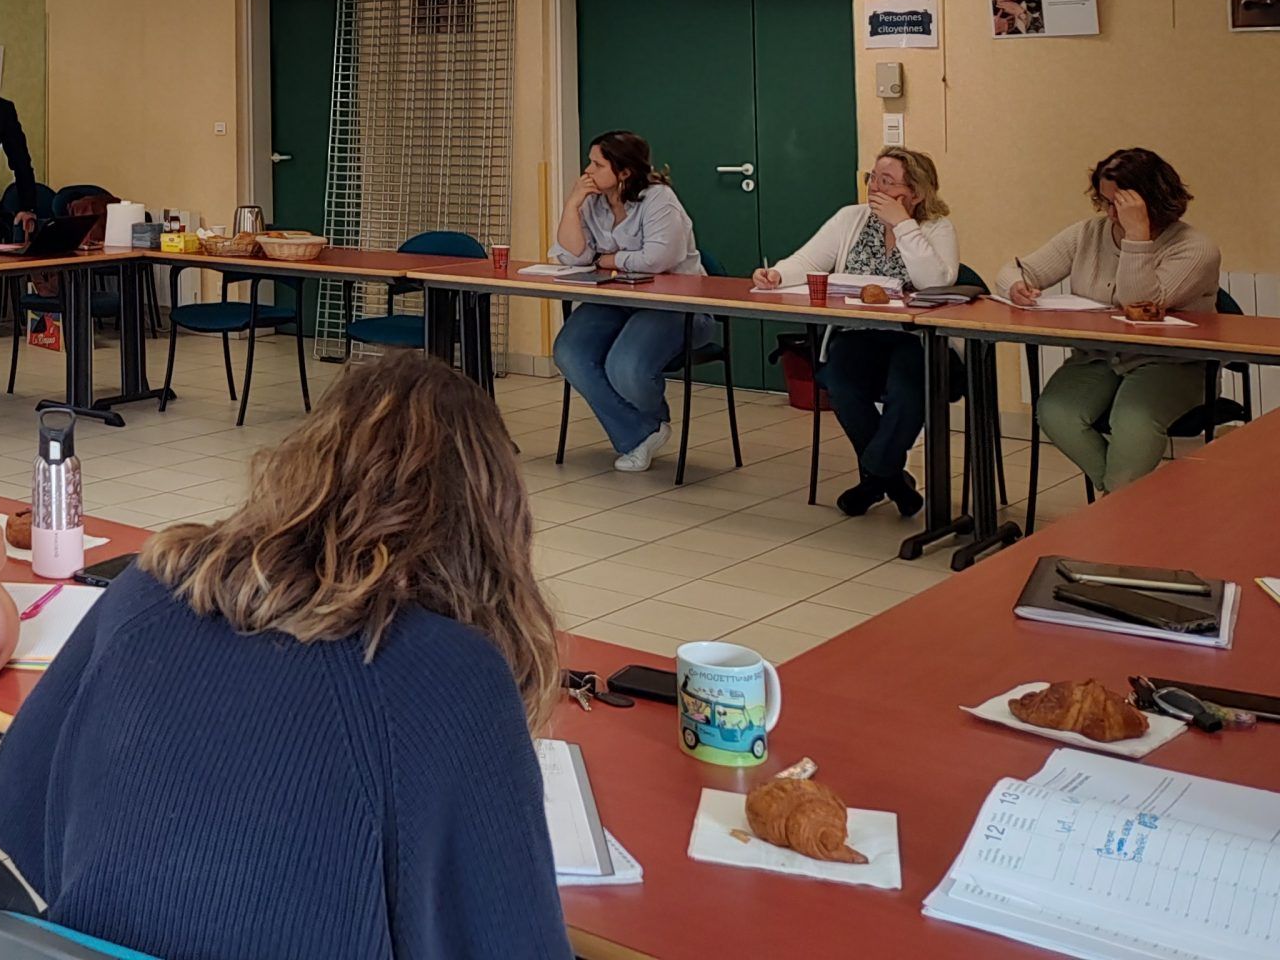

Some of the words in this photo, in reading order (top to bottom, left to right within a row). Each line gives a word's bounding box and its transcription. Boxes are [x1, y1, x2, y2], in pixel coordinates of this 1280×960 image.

[880, 14, 922, 22] Personnes
[877, 25, 924, 34] citoyennes
[999, 791, 1020, 805] 13
[984, 824, 1006, 841] 12
